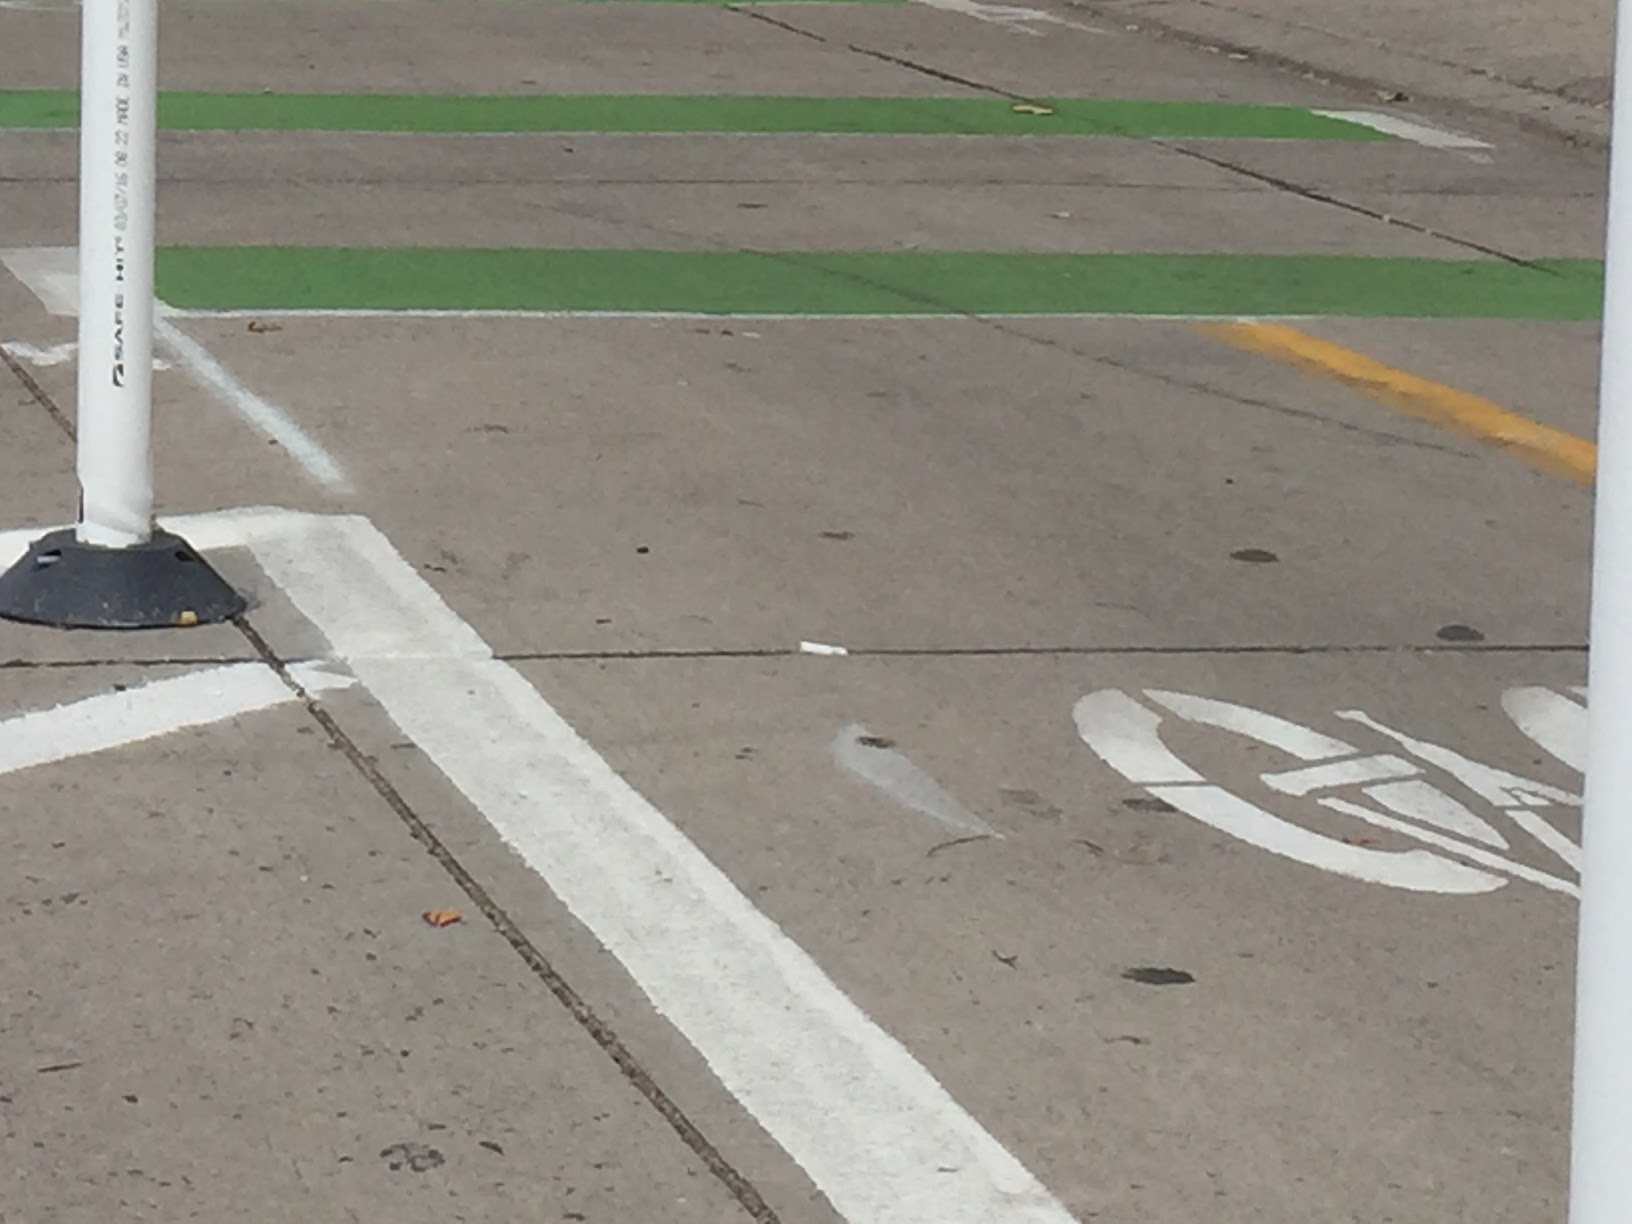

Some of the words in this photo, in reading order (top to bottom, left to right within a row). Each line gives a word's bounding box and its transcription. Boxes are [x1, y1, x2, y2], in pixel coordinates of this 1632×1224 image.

[116, 97, 129, 126] MADE
[115, 236, 124, 281] HIT
[114, 294, 124, 360] SAFE
